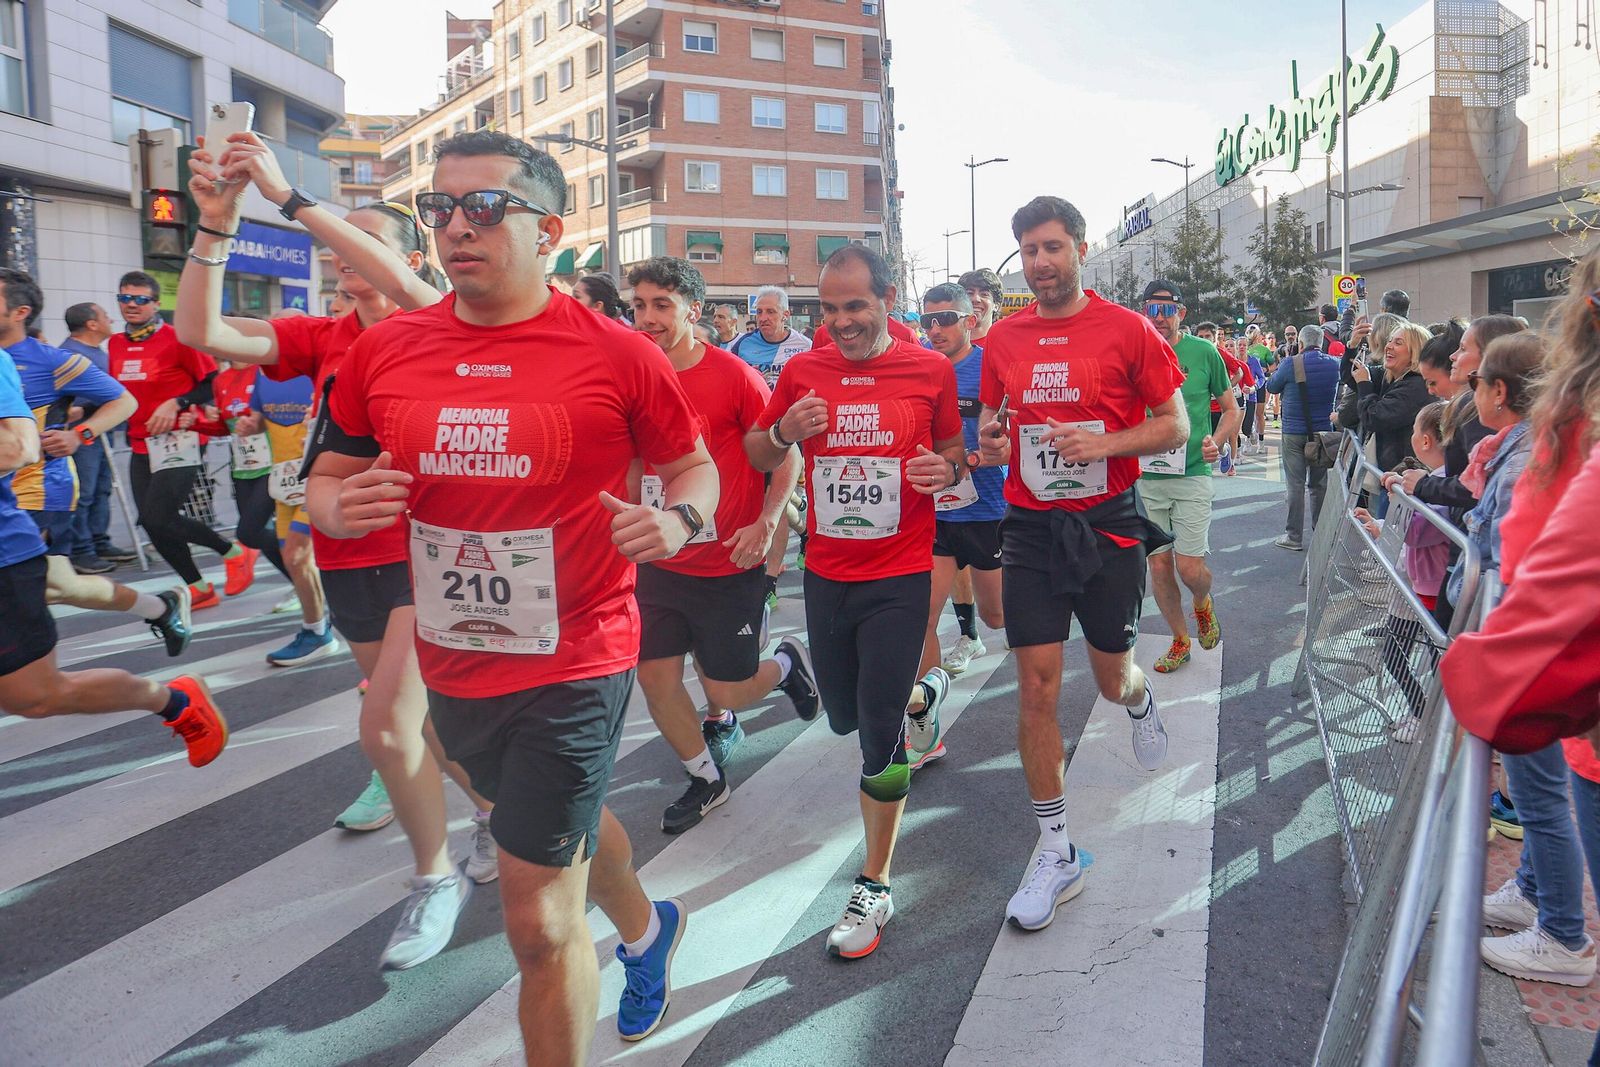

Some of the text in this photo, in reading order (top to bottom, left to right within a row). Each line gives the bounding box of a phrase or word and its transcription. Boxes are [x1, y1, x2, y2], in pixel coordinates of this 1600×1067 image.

[1341, 281, 1353, 289] 30
[471, 364, 512, 373] OXIMESA
[1032, 362, 1069, 373] MEMORIAL
[1031, 372, 1069, 389] PADRE
[1023, 388, 1081, 404] MARCELINO
[437, 408, 509, 425] MEMORIAL
[836, 404, 880, 416] MEMORIAL
[836, 414, 880, 432] PADRE
[435, 425, 509, 453] PADRE
[827, 431, 894, 448] MARCELINO
[419, 453, 532, 478] MARCELINO
[1072, 468, 1086, 476] JOSÉ
[826, 483, 883, 505] 1549
[513, 534, 545, 543] OXIMESA
[442, 571, 511, 605] 210
[450, 603, 471, 614] JOSÉ
[473, 604, 510, 617] ANDRÉS
